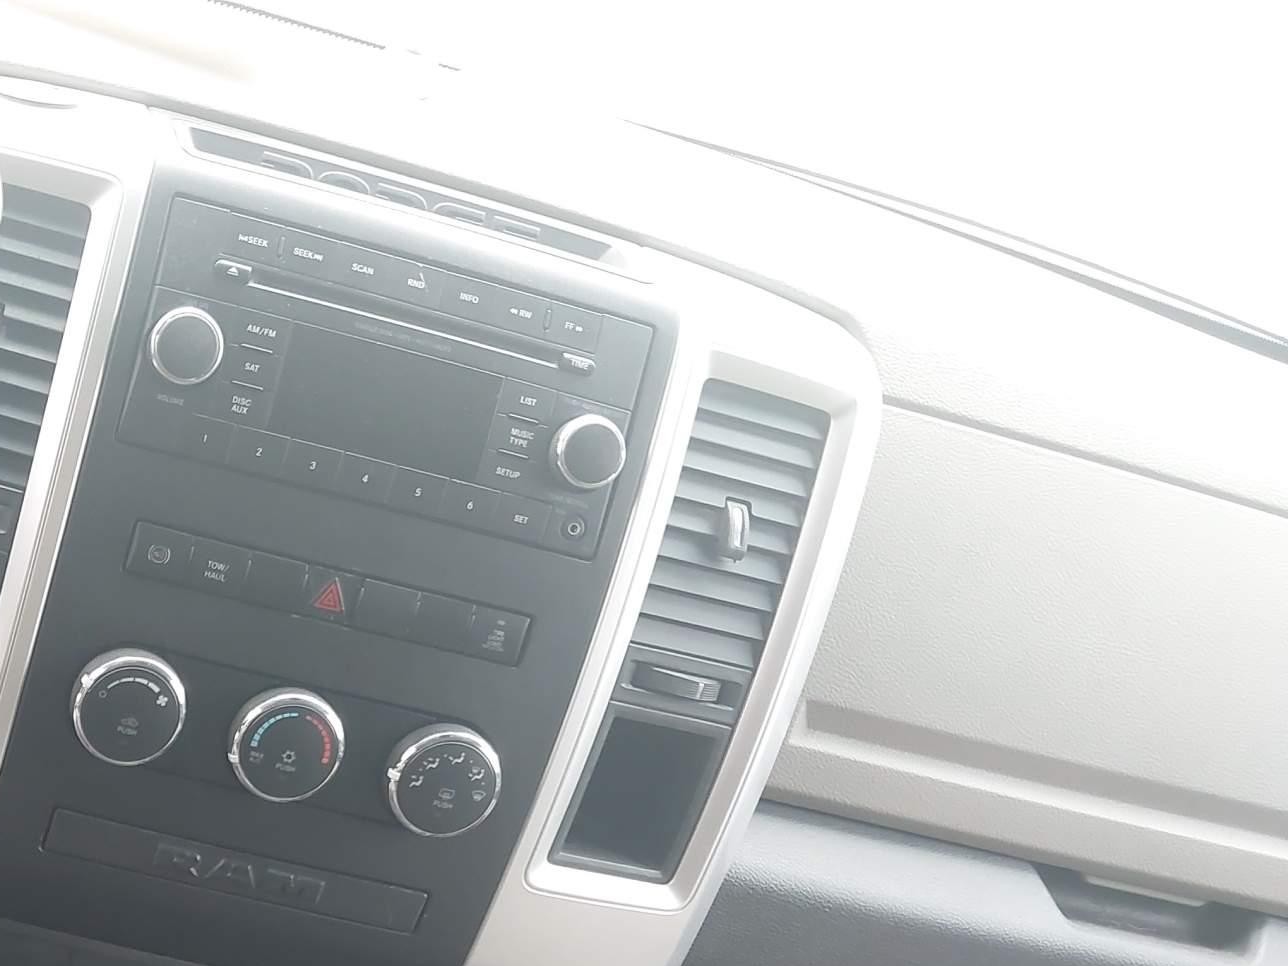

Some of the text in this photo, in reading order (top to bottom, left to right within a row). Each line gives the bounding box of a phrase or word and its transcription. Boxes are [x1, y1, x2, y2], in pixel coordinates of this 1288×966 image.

[248, 235, 269, 248] SEEK
[293, 247, 313, 260] SEEK
[351, 262, 375, 276] SCAN
[407, 278, 426, 290] RND
[459, 292, 480, 304] INFO
[246, 324, 278, 338] AM/FM
[244, 362, 261, 373] SAT
[231, 395, 253, 407] DISC
[519, 395, 538, 407] LIST
[231, 404, 249, 415] AUX
[202, 433, 208, 444] 1
[510, 428, 535, 440] MUSIC
[509, 437, 528, 448] TYPE
[255, 447, 263, 457] 2
[309, 461, 317, 471] 3
[495, 466, 521, 479] SETUP
[361, 474, 369, 484] 4
[414, 487, 422, 498] 5
[466, 500, 474, 510] 6
[513, 514, 529, 525] SET
[204, 570, 226, 583] HAUL
